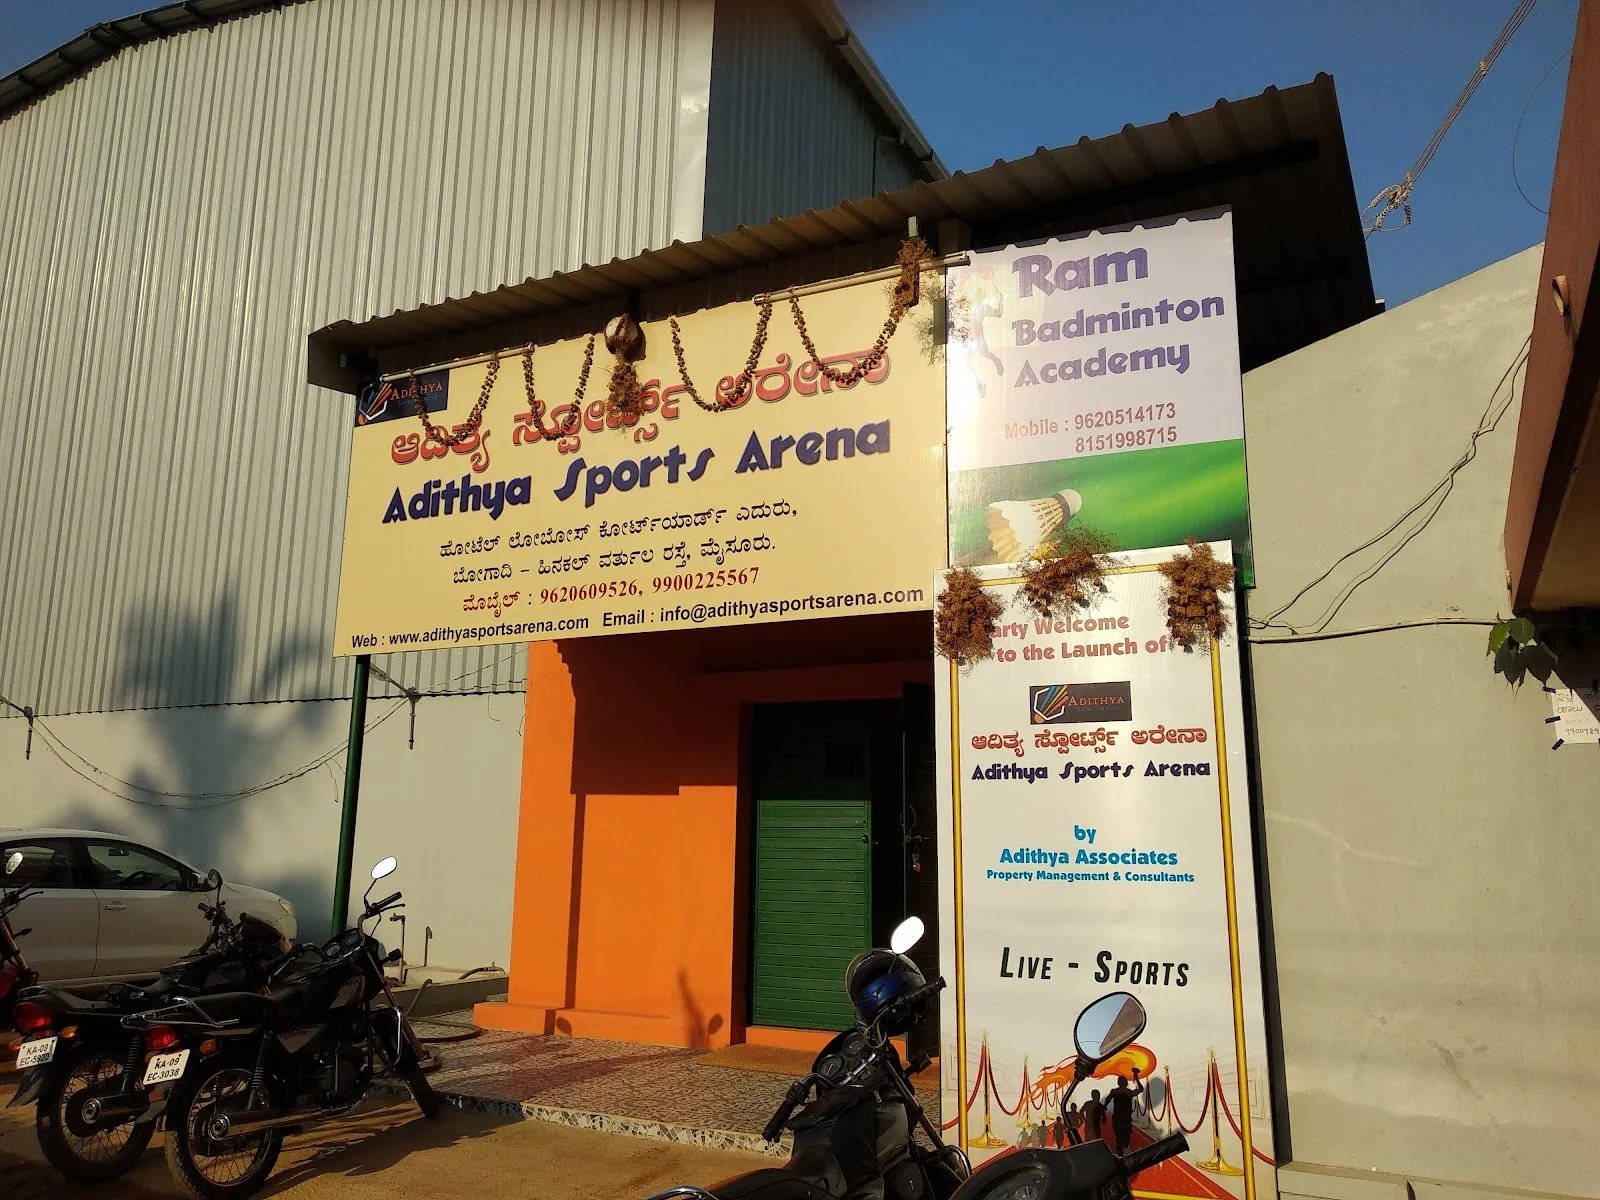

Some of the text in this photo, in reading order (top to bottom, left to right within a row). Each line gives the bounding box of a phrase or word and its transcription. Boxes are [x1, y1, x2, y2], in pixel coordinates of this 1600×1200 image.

[1012, 248, 1148, 298] Ram
[1012, 296, 1225, 346] Badminton
[1014, 343, 1190, 388] Academy
[391, 382, 443, 400] ADIHYA
[1004, 418, 1059, 440] Mobile
[1074, 402, 1176, 430] 9620514173
[1075, 426, 1177, 453] 8151998715
[382, 420, 891, 523] Adithya Sports Arena
[440, 535, 501, 557] ಹೋಟೆಲ್
[736, 498, 798, 521] ಎದುರು,
[453, 562, 513, 584] ಬೋಗಾದಿ
[538, 553, 591, 575] ಹಿನಕಲ್
[663, 541, 691, 568] ರಸ್ತೆ,
[700, 533, 776, 565] ಮೈಸೂರು.
[463, 590, 520, 617] ಮೊಬೈಲ್
[540, 578, 643, 605] 9620609526,
[652, 567, 760, 594] 9900225567
[352, 634, 378, 648] Web
[389, 617, 589, 645] www.adithyasportsarena.com
[603, 611, 645, 627] Email
[660, 587, 924, 623] info@adithyasportsarena.com
[1034, 615, 1130, 635] Welcome
[996, 635, 1168, 662] to the Launch of
[1068, 694, 1125, 707] ADITHYA
[971, 725, 1208, 757] ಆದಿತ್ಯ ಸ್ಪೋರ್ಟ್ಸ್ ಅರೇನಾ
[971, 760, 1210, 784] Adithya Sports Arena
[1074, 825, 1096, 843] by
[999, 848, 1178, 867] Adithya Associates
[986, 869, 1195, 882] Property Management & Consultants
[26, 1043, 49, 1056] KA-09
[147, 1068, 180, 1081] EC-3038
[154, 1057, 180, 1070] KA-09
